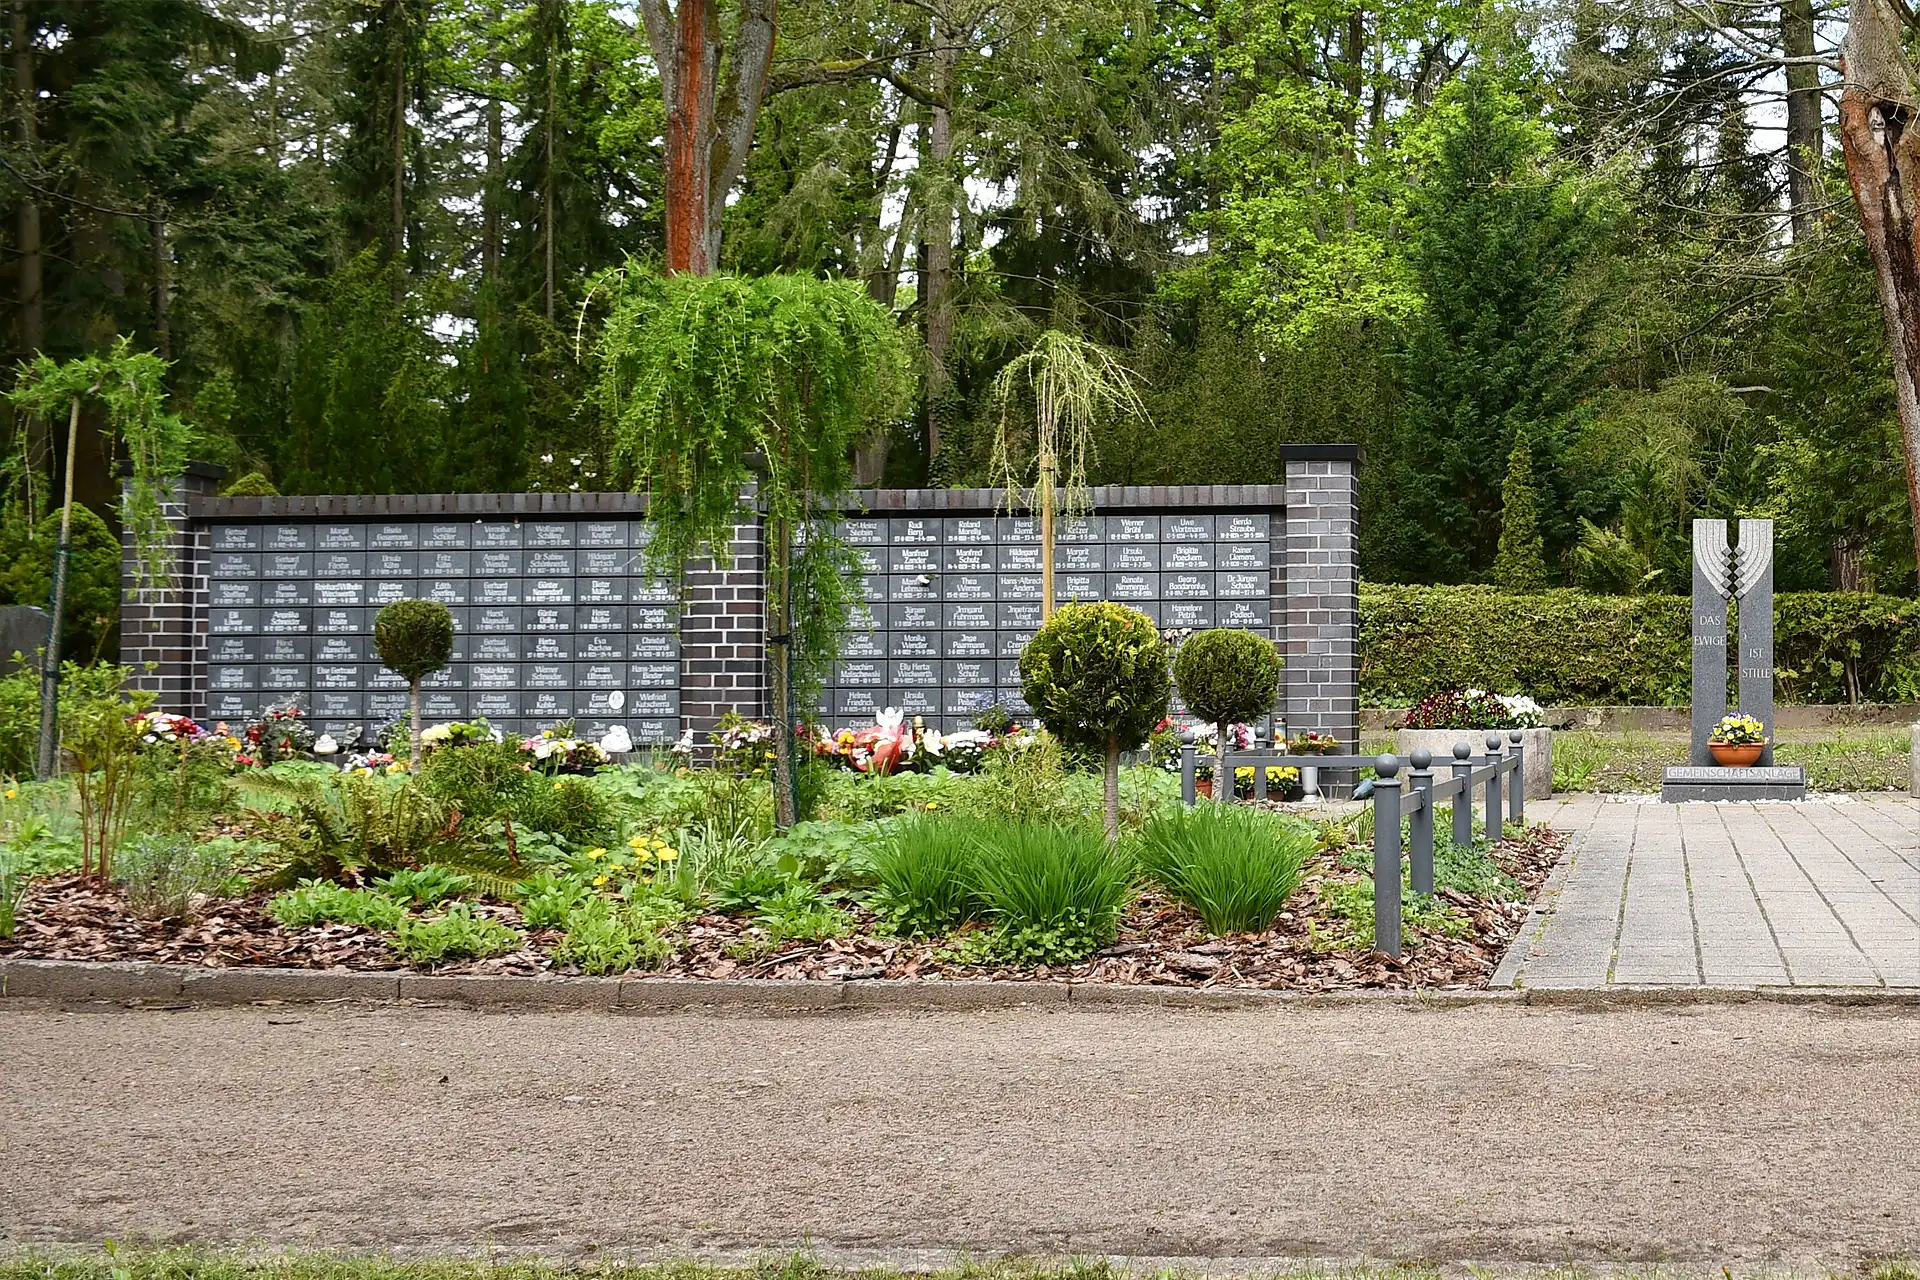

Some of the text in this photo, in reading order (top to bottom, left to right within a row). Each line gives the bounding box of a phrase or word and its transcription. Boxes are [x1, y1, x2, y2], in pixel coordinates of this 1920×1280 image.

[535, 525, 565, 534] Wolfgang
[909, 521, 924, 529] Rudi
[908, 529, 924, 538] Berg
[588, 552, 617, 560] Hildegard
[1009, 548, 1039, 556] Hildegard
[437, 554, 451, 562] Fritz
[904, 556, 927, 564] Zander
[961, 578, 978, 586] Thea
[1177, 575, 1196, 584] Georg
[1235, 604, 1250, 612] Paul
[1699, 616, 1721, 626] DAS
[1694, 635, 1727, 646] EWIGE
[1748, 648, 1764, 659] IST
[1742, 667, 1771, 679] STILLE
[1668, 767, 1799, 779] GEMEINSCHAFTSANLAGE
